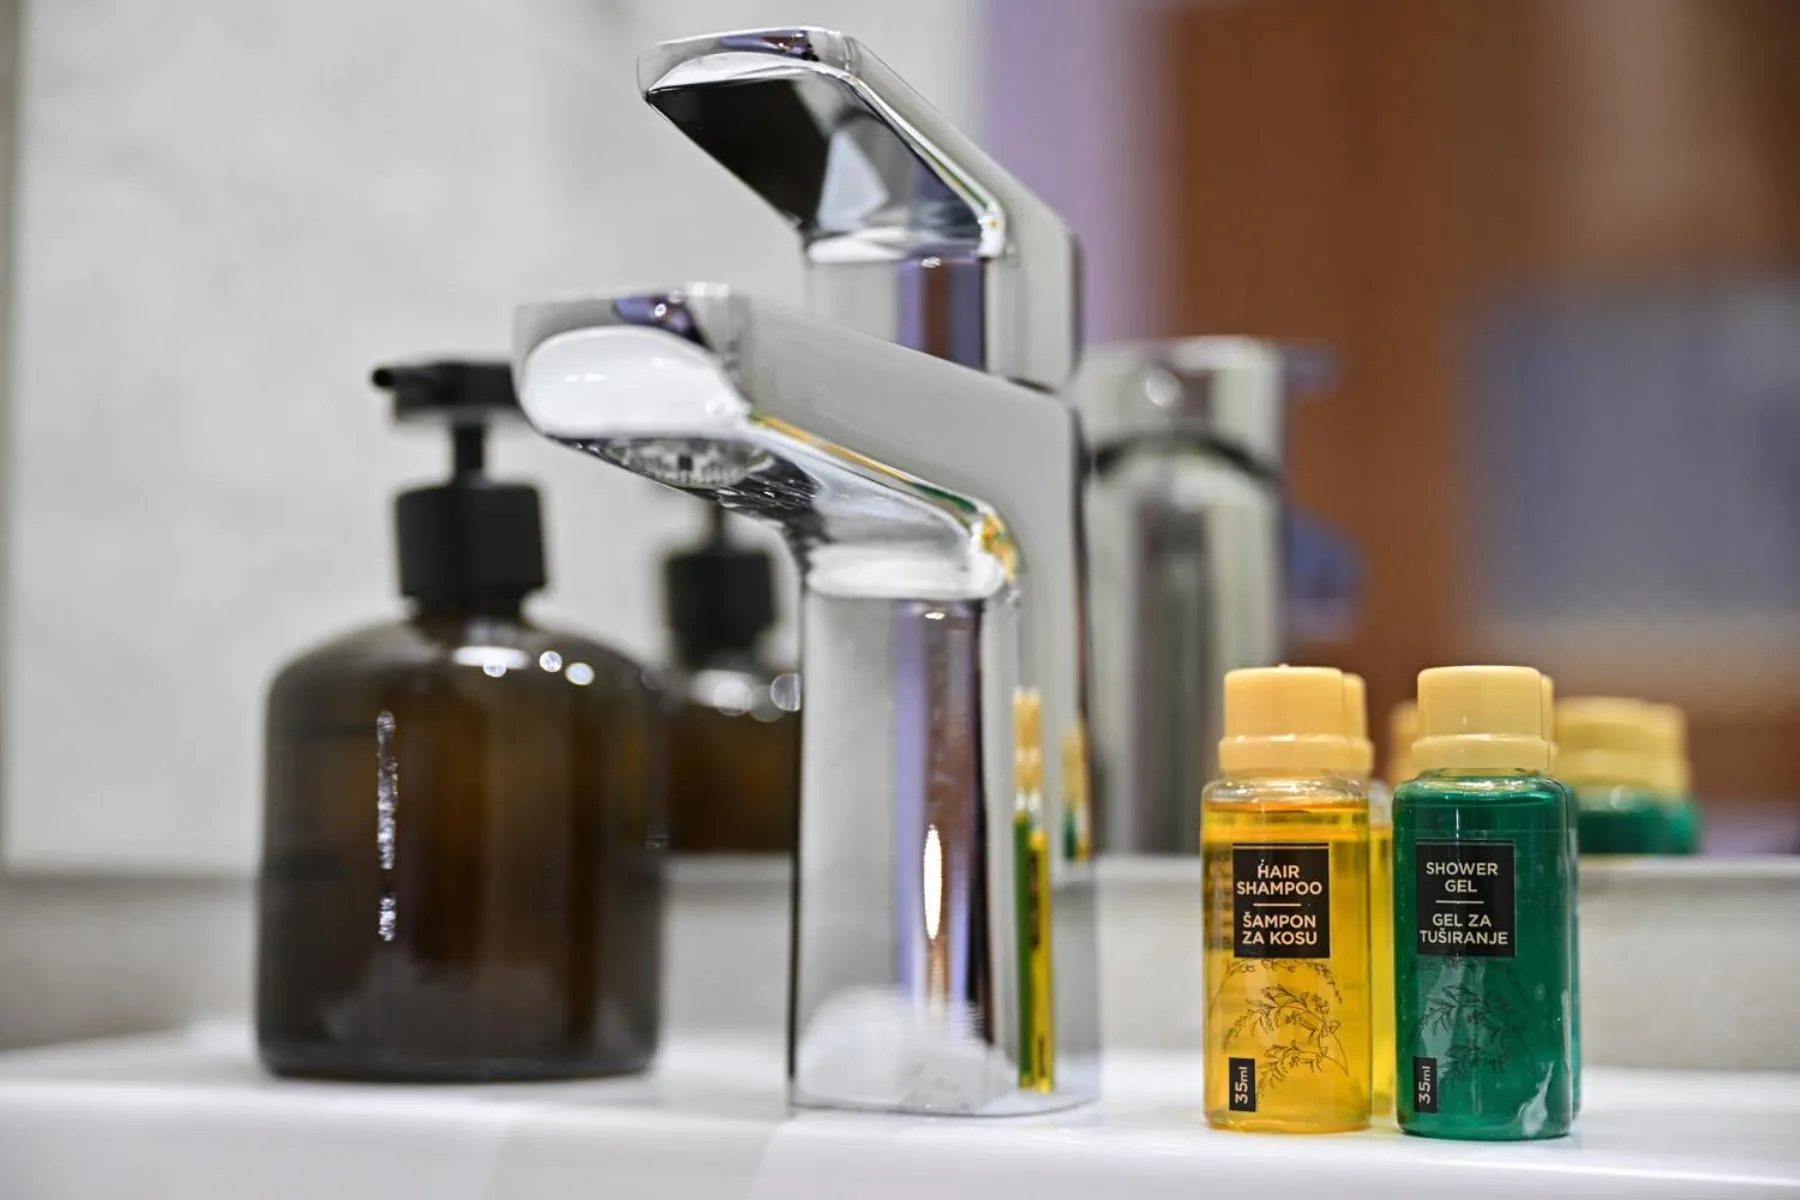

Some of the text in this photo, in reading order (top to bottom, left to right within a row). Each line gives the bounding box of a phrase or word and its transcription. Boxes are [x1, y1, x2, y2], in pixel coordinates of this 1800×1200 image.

[1257, 865, 1300, 879] HAIR
[1425, 862, 1499, 876] SHOWER
[1236, 881, 1323, 895] SHAMPOO
[1444, 879, 1478, 893] GEL
[1242, 911, 1317, 929] ŠAMPON
[1432, 913, 1492, 928] GEL ZA
[1242, 931, 1318, 946] ZA KOSU
[1419, 927, 1509, 945] TUŠIRANJE
[1234, 1066, 1249, 1105] 35ml
[1418, 1065, 1432, 1105] 35ml
